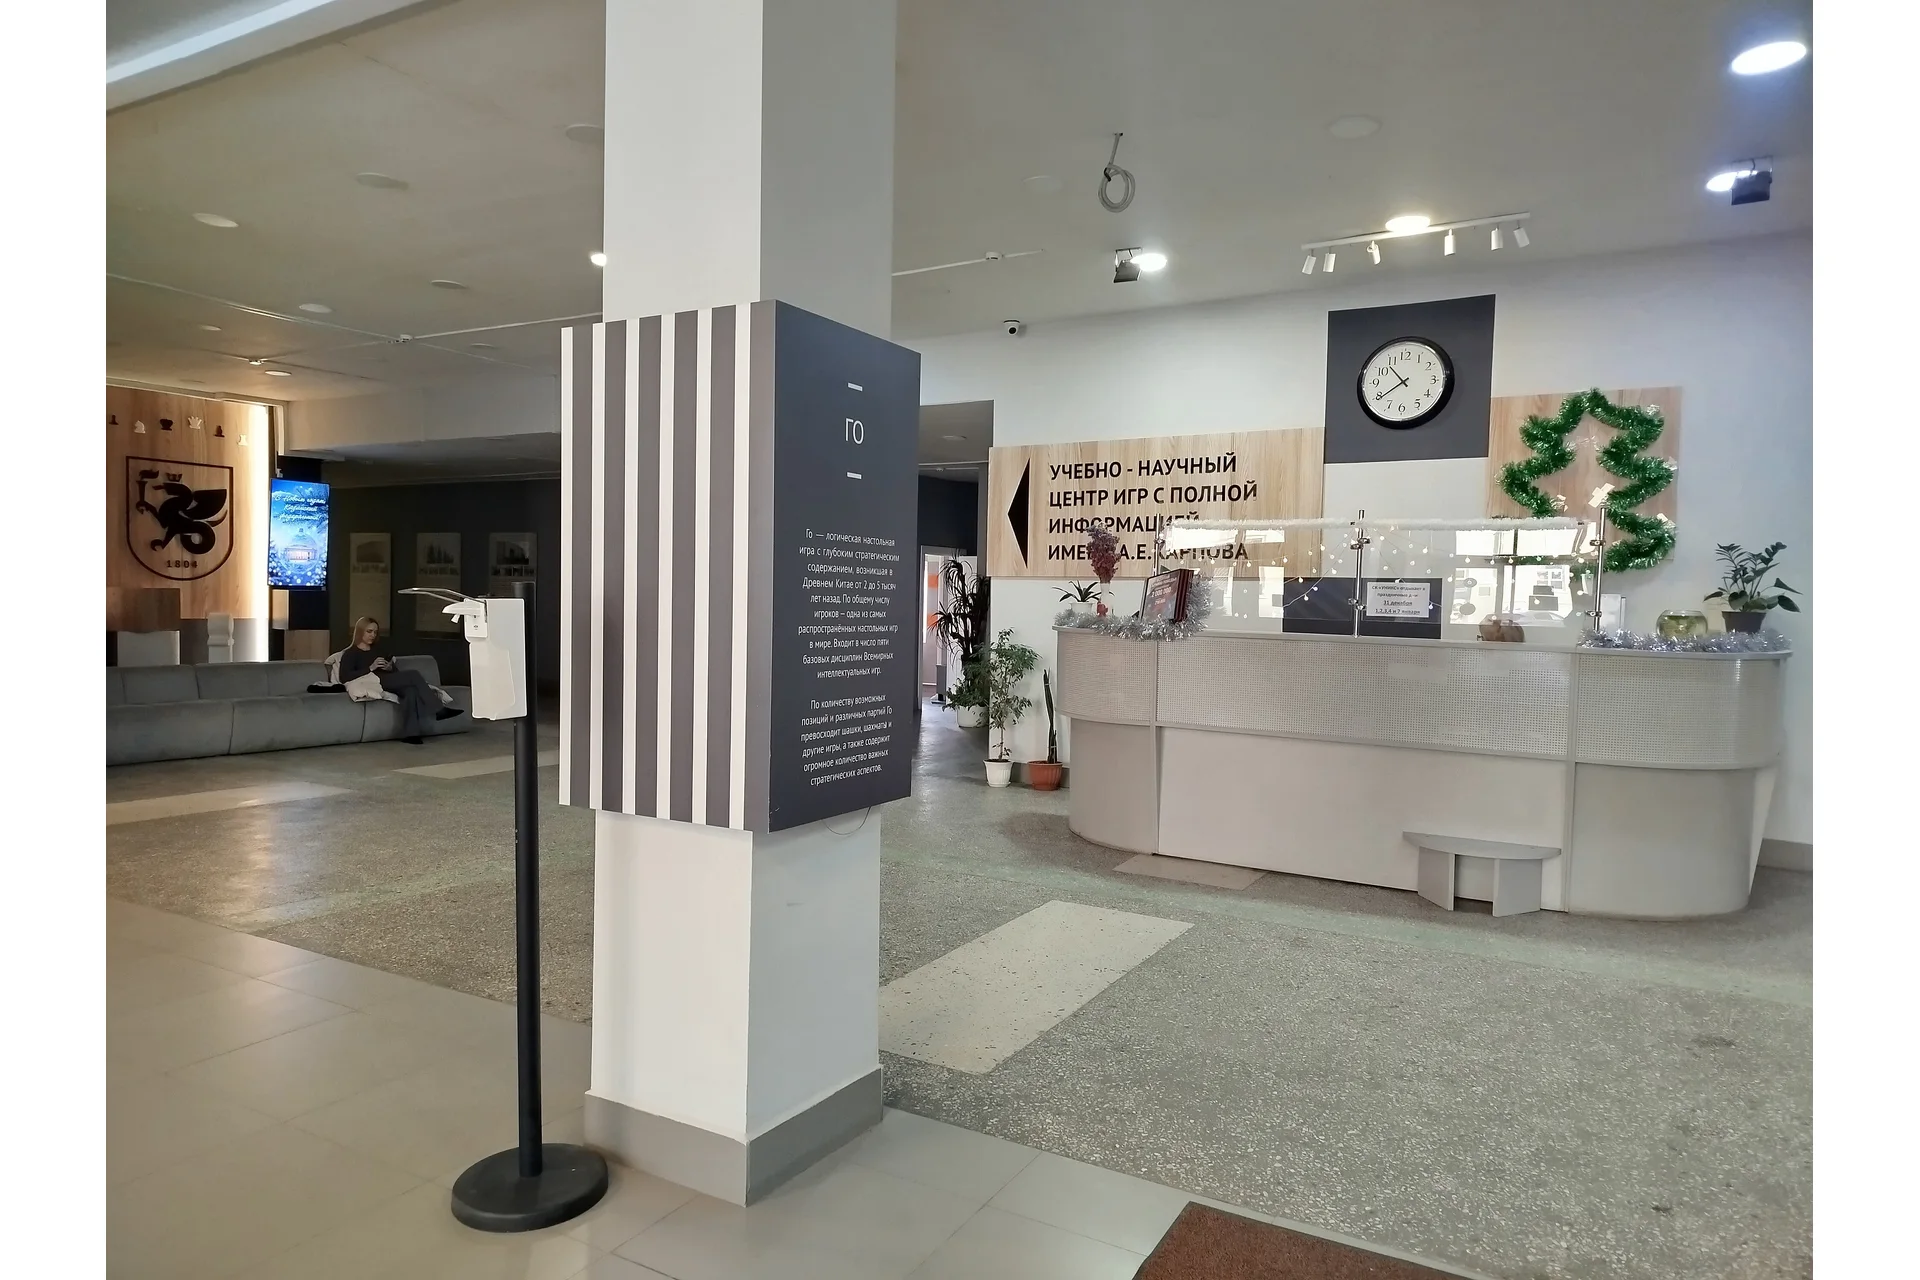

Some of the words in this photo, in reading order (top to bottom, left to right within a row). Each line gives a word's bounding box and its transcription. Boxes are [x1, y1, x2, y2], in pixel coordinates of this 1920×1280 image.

[1388, 356, 1396, 365] 11
[1400, 352, 1411, 360] 12
[1378, 367, 1388, 376] 10
[1425, 362, 1431, 370] 2
[1372, 378, 1379, 387] 9
[1430, 375, 1436, 384] 3
[1376, 392, 1382, 400] 8
[1424, 389, 1430, 397] 4
[1386, 400, 1393, 409] 7
[1398, 403, 1405, 412] 6
[1414, 399, 1420, 408] 5
[845, 418, 864, 444] ГО
[1050, 461, 1122, 480] УЧЕБНО
[1138, 452, 1236, 476] НАУЧНЫЙ
[1049, 489, 1108, 509] ЦЕНТР
[1114, 488, 1148, 506] ИГР
[1153, 486, 1164, 504] С
[1170, 480, 1257, 503] ПОЛНОЙ
[1049, 511, 1199, 534] ИНФОРМАЦИ
[805, 528, 813, 539] Го
[826, 533, 862, 544] логическая
[863, 536, 895, 546] настольная
[799, 547, 814, 557] игра
[822, 547, 853, 561] глубоким
[855, 552, 900, 562] стратегическим
[1048, 544, 1098, 560] ИМЕ
[166, 560, 198, 568] 1804
[807, 562, 854, 574] содержанием,
[856, 566, 888, 576] возникшая
[803, 576, 833, 589] Древнем
[836, 579, 854, 589] Китае
[855, 581, 862, 589] от
[864, 580, 867, 589] 2
[868, 582, 876, 590] до
[877, 580, 880, 589] 5
[881, 582, 896, 590] тысяч
[810, 594, 821, 603] лет
[842, 594, 850, 603] По
[852, 594, 874, 605] общему
[875, 597, 890, 606] числу
[814, 609, 839, 620] игроков
[846, 610, 860, 619] одна
[857, 624, 888, 632] настольных
[890, 624, 898, 634] игр
[809, 641, 814, 649] в
[815, 640, 833, 650] мире.
[834, 638, 854, 649] Входит
[860, 638, 876, 647] число
[877, 638, 889, 646] пяти
[802, 654, 829, 664] базовых
[831, 653, 862, 664] дисциплин
[864, 651, 894, 661] Всемирных
[817, 666, 870, 679] интеллектуальных
[810, 699, 820, 710] По
[821, 698, 855, 708] количеству
[855, 694, 886, 704] возможных
[801, 714, 828, 726] позиций
[835, 711, 866, 723] различных
[867, 707, 886, 719] партий
[886, 705, 893, 715] Го
[801, 728, 841, 743] превосходит
[841, 724, 862, 736] шашки,
[864, 721, 887, 732] шахматы
[802, 746, 825, 758] другие
[825, 744, 841, 755] игры,
[847, 740, 864, 748] также
[865, 734, 890, 746] содержит
[803, 758, 834, 772] огромное
[835, 752, 867, 766] количество
[868, 749, 889, 760] важных
[810, 770, 856, 787] стратегических
